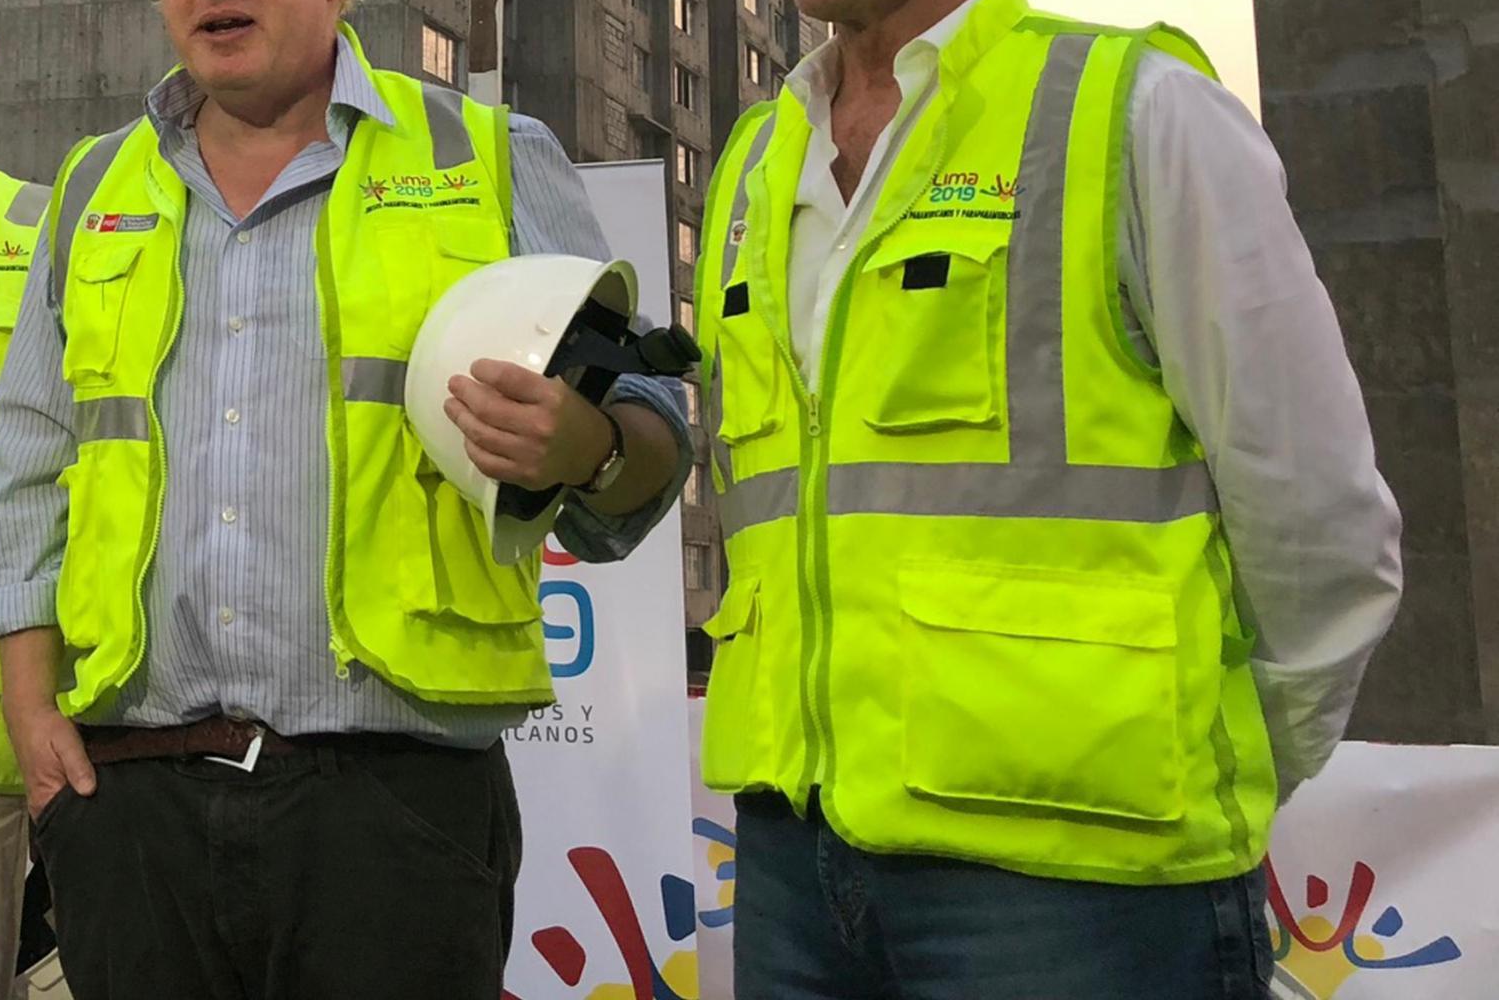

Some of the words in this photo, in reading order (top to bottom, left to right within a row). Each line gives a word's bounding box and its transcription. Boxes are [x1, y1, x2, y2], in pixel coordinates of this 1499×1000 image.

[395, 185, 433, 198] 2019
[930, 186, 976, 203] 2019
[581, 704, 593, 721] Y
